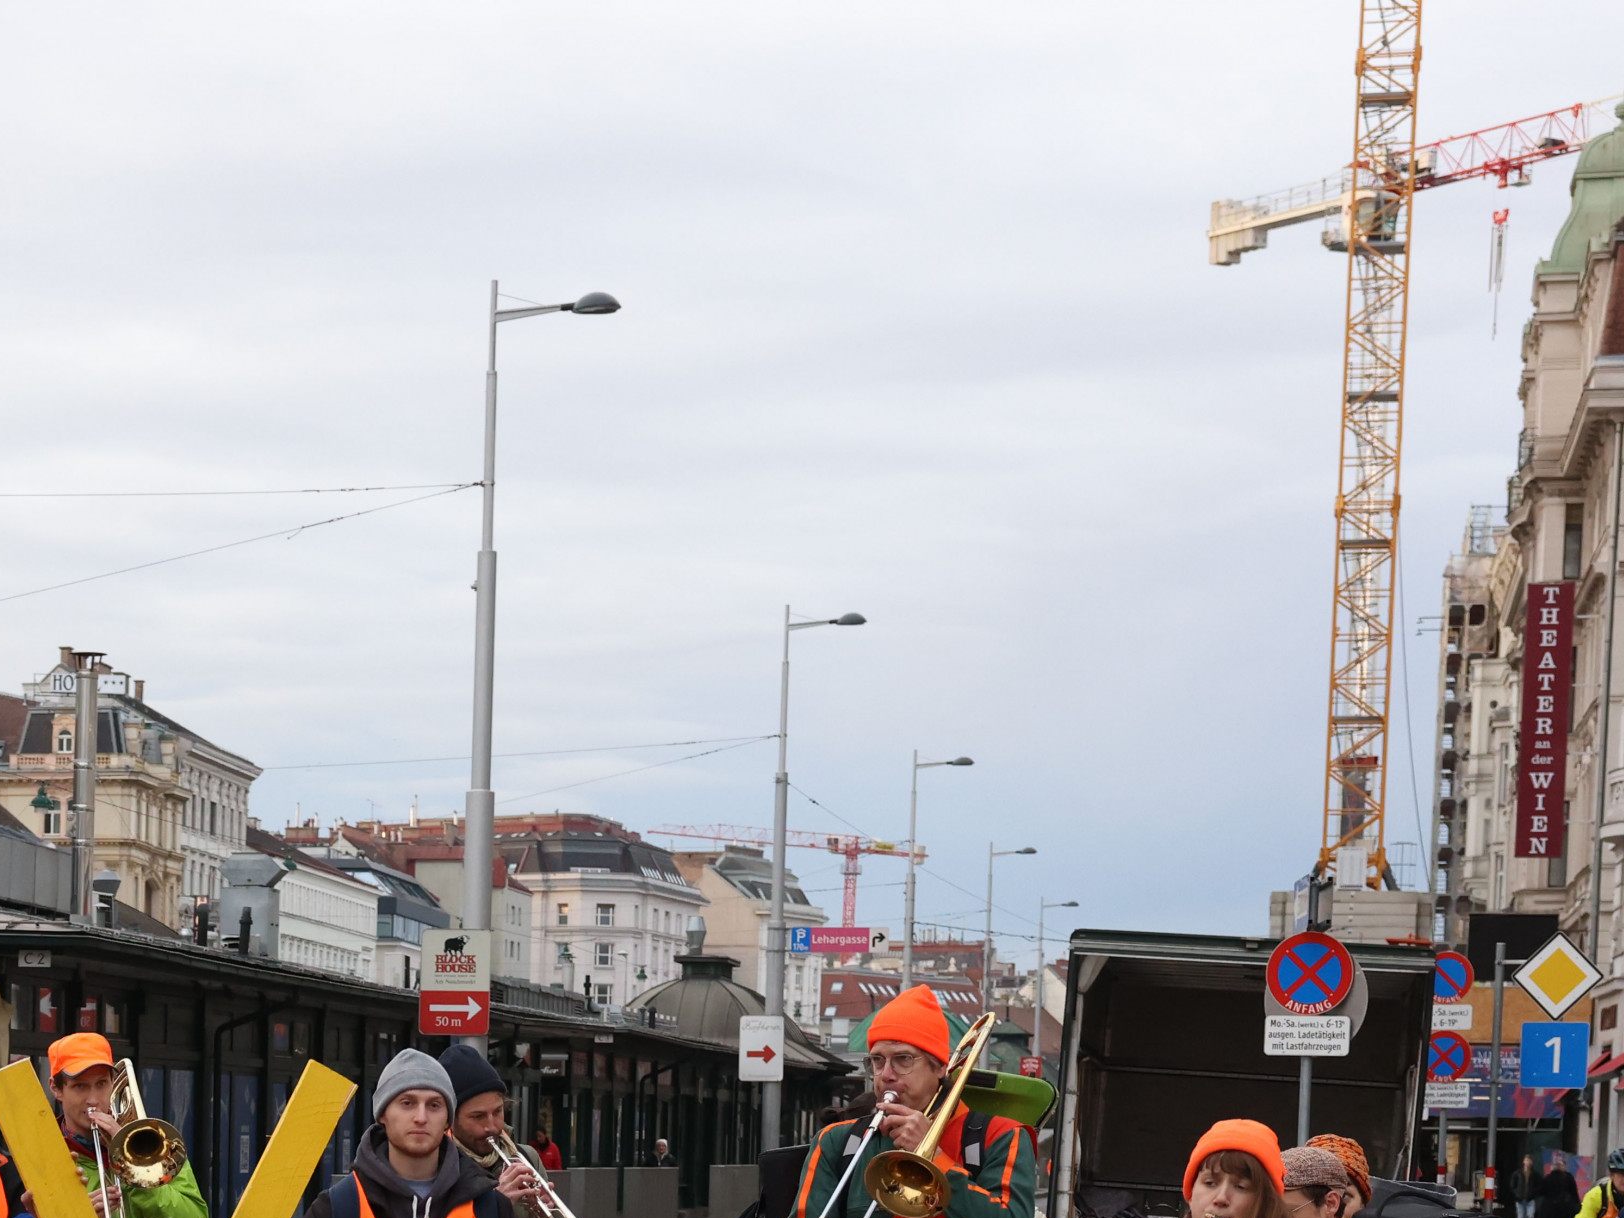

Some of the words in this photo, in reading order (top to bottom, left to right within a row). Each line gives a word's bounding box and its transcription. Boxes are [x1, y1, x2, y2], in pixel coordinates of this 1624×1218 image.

[1535, 586, 1560, 735] THEATER
[1534, 739, 1551, 750] an
[1530, 754, 1554, 765] der
[1528, 772, 1555, 855] WIEN
[811, 934, 868, 946] Lehargasse
[435, 954, 476, 964] BLOCK
[435, 964, 476, 973] HOUSE
[1284, 999, 1333, 1014] ANFANG
[435, 1016, 449, 1027] 50
[451, 1018, 462, 1027] m
[1268, 1031, 1295, 1041] ausgen.
[1297, 1029, 1346, 1041] Ladetätigkeit
[1272, 1041, 1284, 1050] mit
[1286, 1041, 1342, 1053] Lastfahrzeugen
[1544, 1036, 1562, 1074] 1
